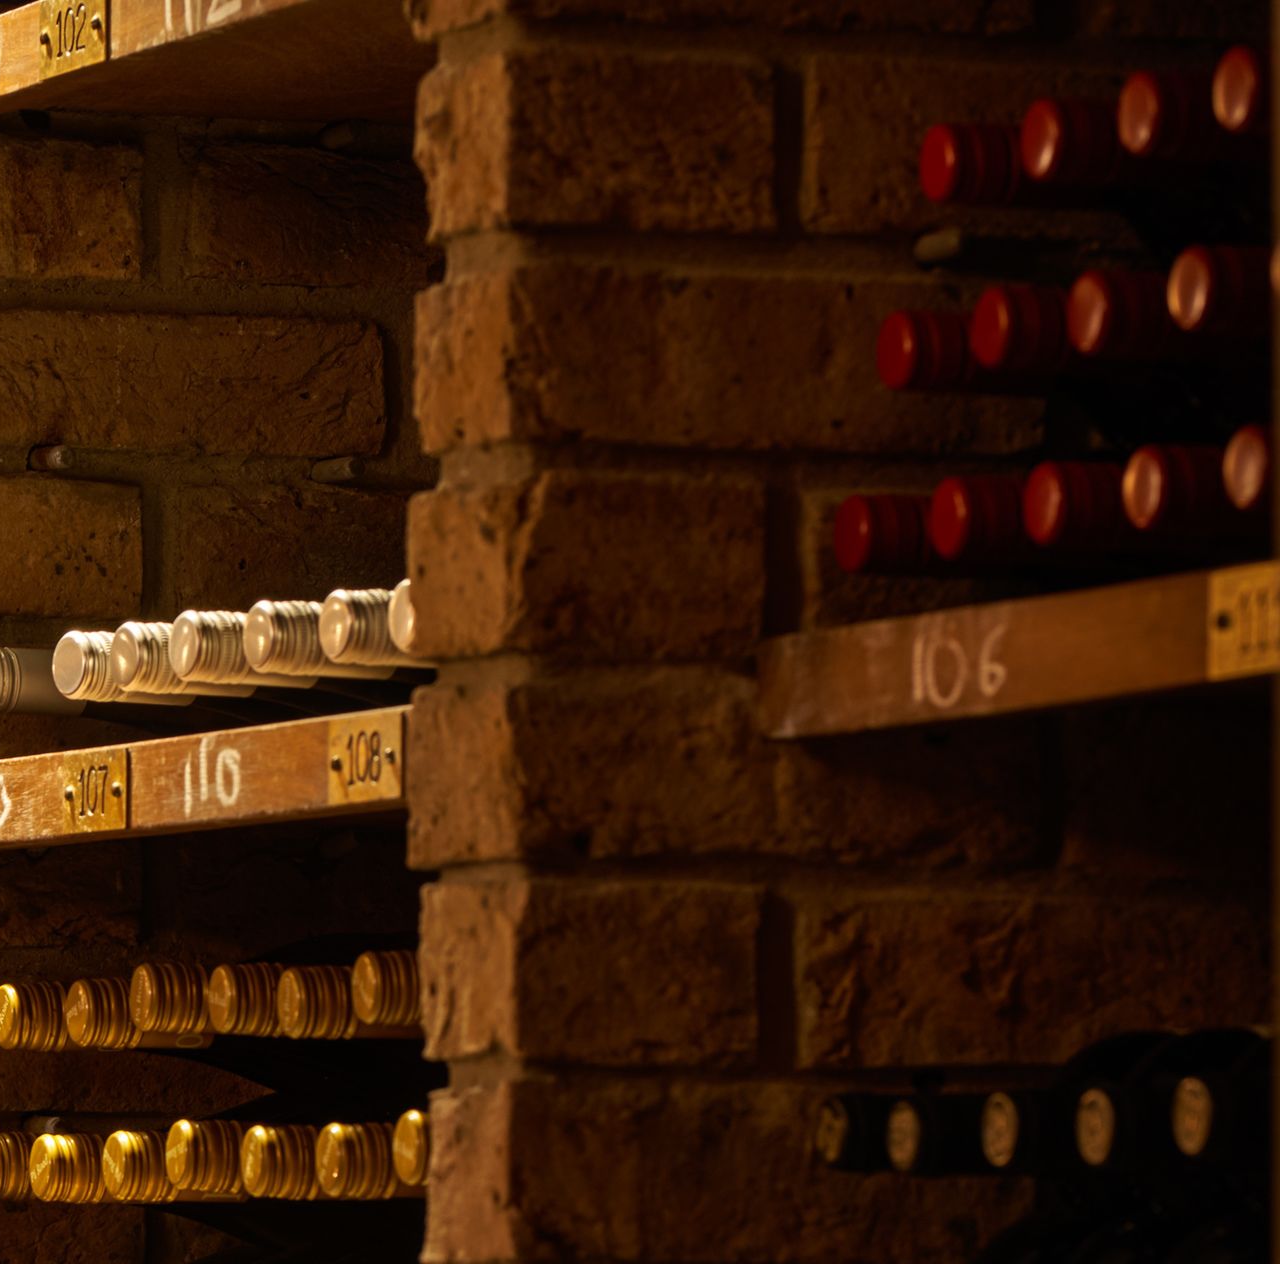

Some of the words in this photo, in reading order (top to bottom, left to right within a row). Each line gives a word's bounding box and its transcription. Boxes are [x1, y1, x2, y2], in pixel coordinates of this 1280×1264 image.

[54, 4, 86, 57] 102
[912, 622, 1007, 707] 106
[346, 730, 381, 787] 108
[78, 765, 109, 818] 107
